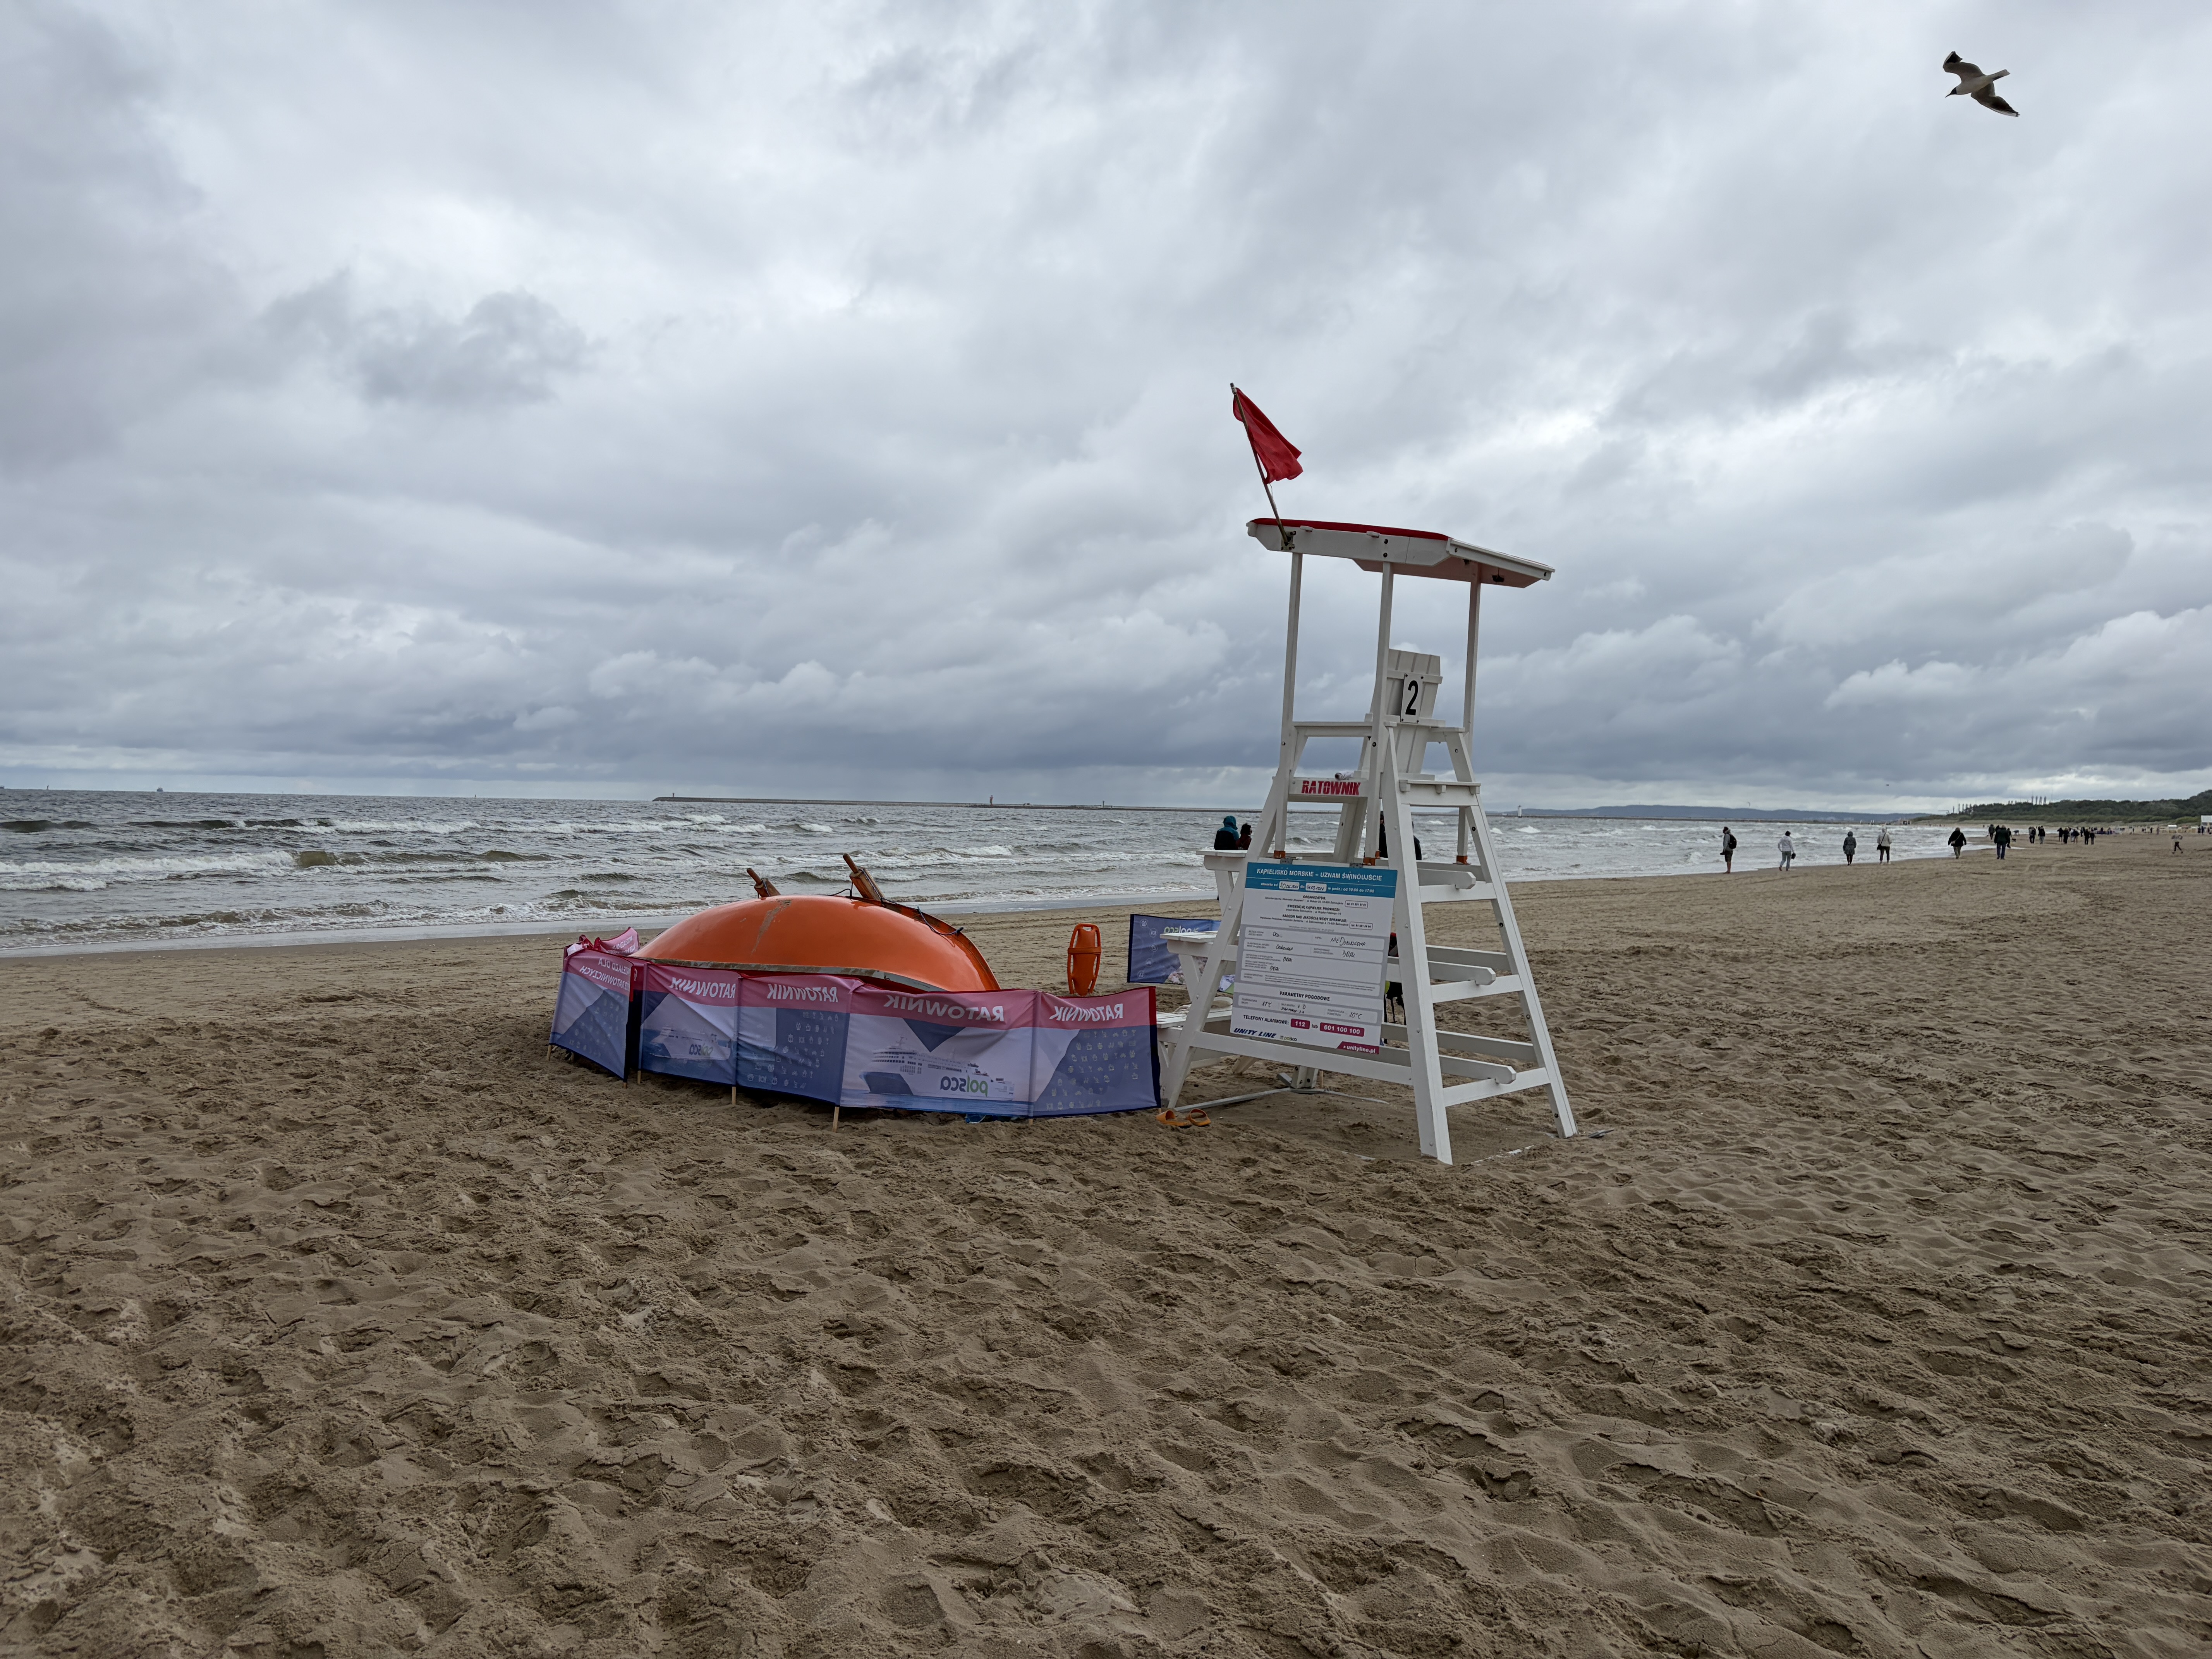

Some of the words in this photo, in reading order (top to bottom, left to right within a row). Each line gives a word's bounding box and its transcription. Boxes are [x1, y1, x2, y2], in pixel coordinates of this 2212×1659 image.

[1405, 680, 1419, 716] 2
[1301, 780, 1361, 795] RATOWNIK
[1342, 872, 1382, 881] ŚWINOUJŚCIE
[1346, 1045, 1376, 1054] unityline.pl
